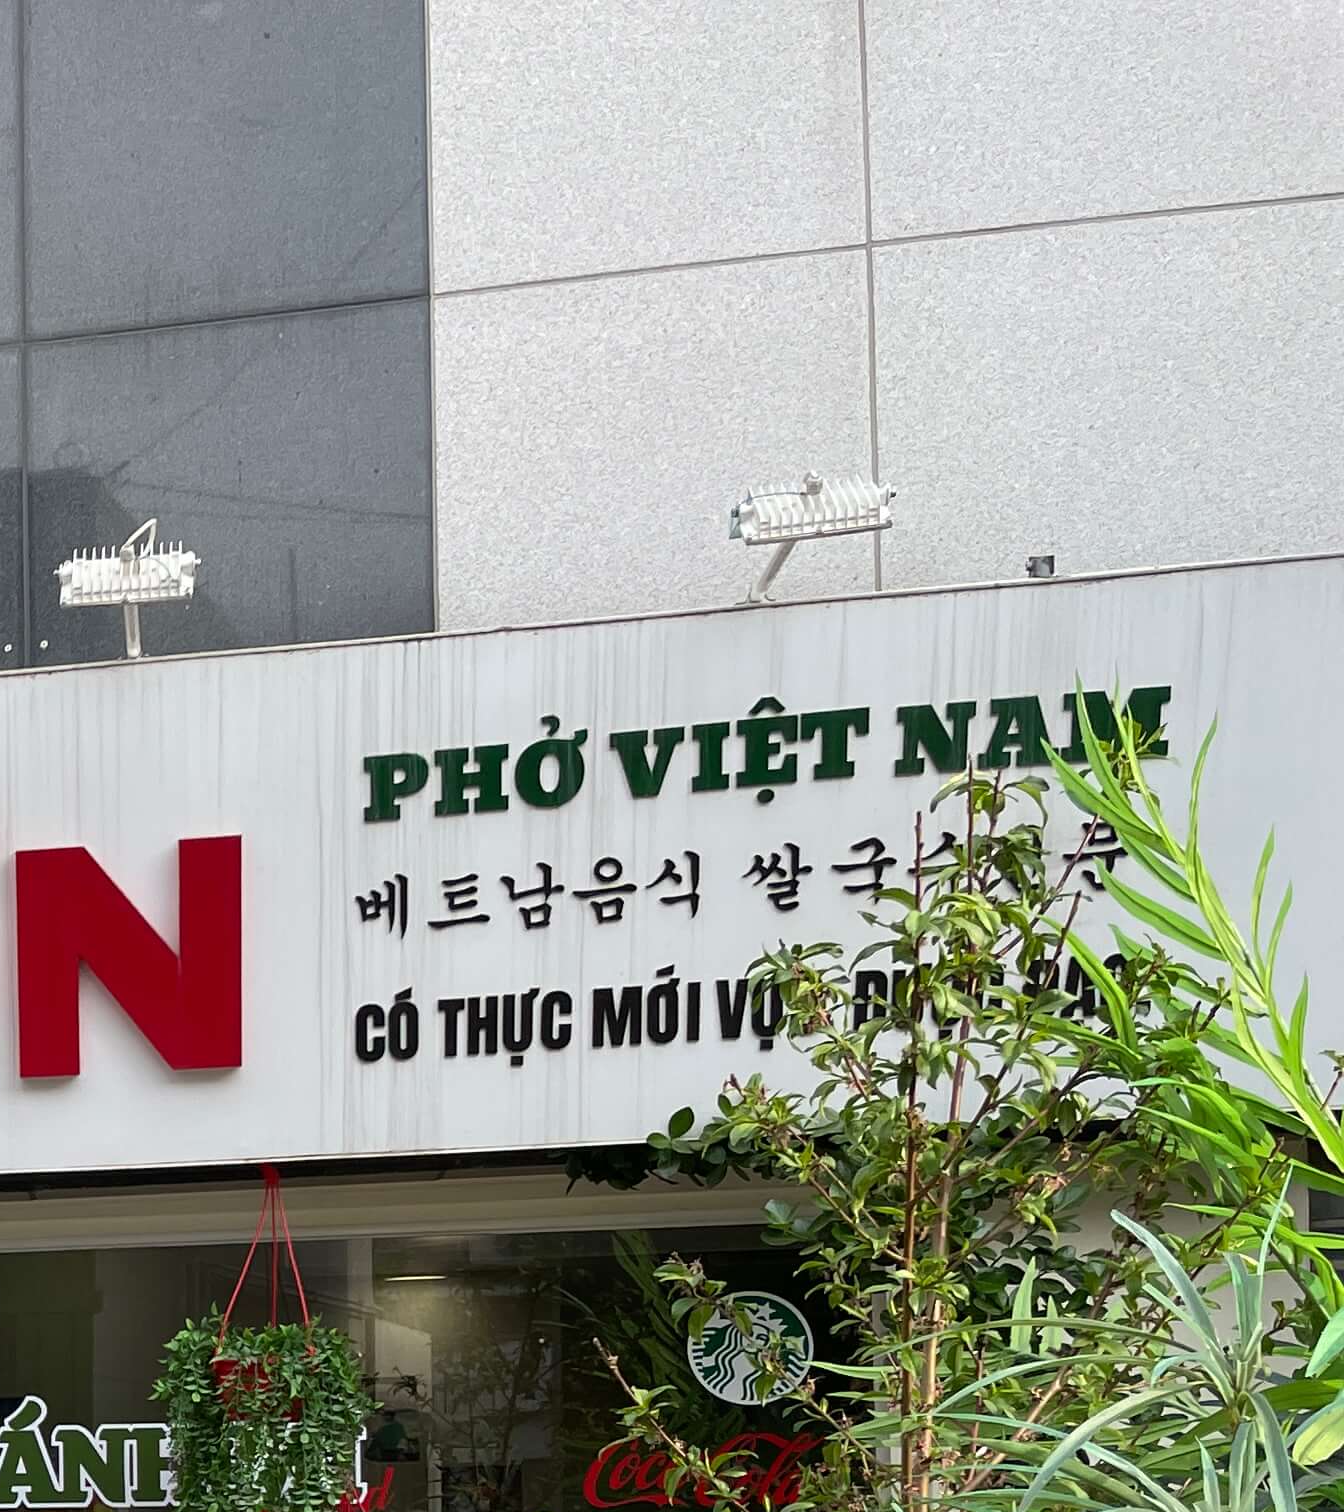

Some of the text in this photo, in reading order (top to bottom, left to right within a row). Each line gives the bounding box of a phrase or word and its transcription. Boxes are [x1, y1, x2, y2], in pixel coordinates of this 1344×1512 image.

[363, 685, 1173, 824] PHỞ VIỆT NAM
[355, 850, 703, 940] 베트남음식
[354, 986, 421, 1064] CÓ
[437, 986, 574, 1068] THỰC
[592, 964, 702, 1046] MỚI
